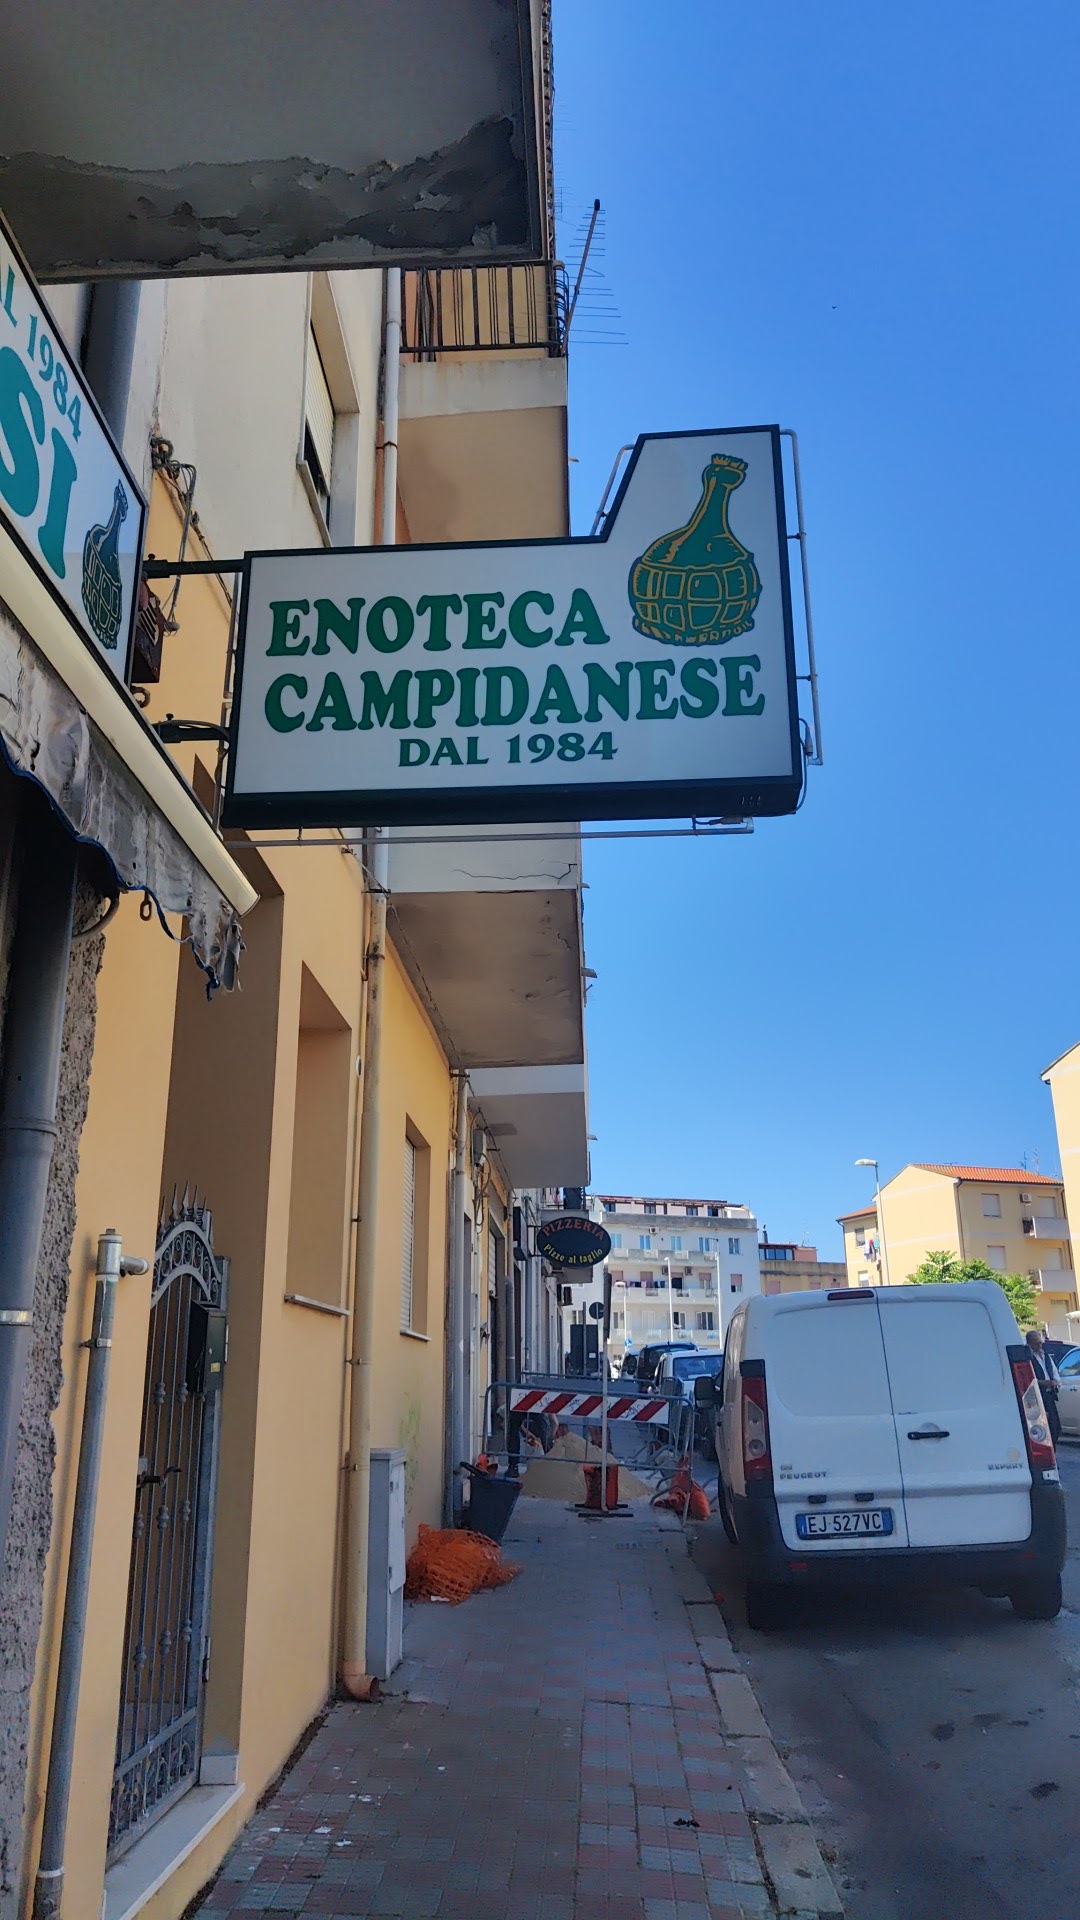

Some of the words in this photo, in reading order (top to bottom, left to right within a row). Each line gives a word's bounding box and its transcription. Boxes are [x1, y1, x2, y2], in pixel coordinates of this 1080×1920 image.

[27, 313, 82, 443] 1984
[265, 588, 610, 656] ENOTECA
[264, 654, 766, 734] CAMPIDANESE
[398, 736, 489, 768] DAL
[506, 731, 618, 764] 1984
[542, 1218, 604, 1241] PIZZERIA
[543, 1243, 565, 1262] Pizze
[568, 1255, 577, 1264] al
[579, 1248, 603, 1263] taglio
[780, 1471, 827, 1480] PEUGEOT
[808, 1516, 827, 1533] EJ
[833, 1513, 881, 1532] 527VC
